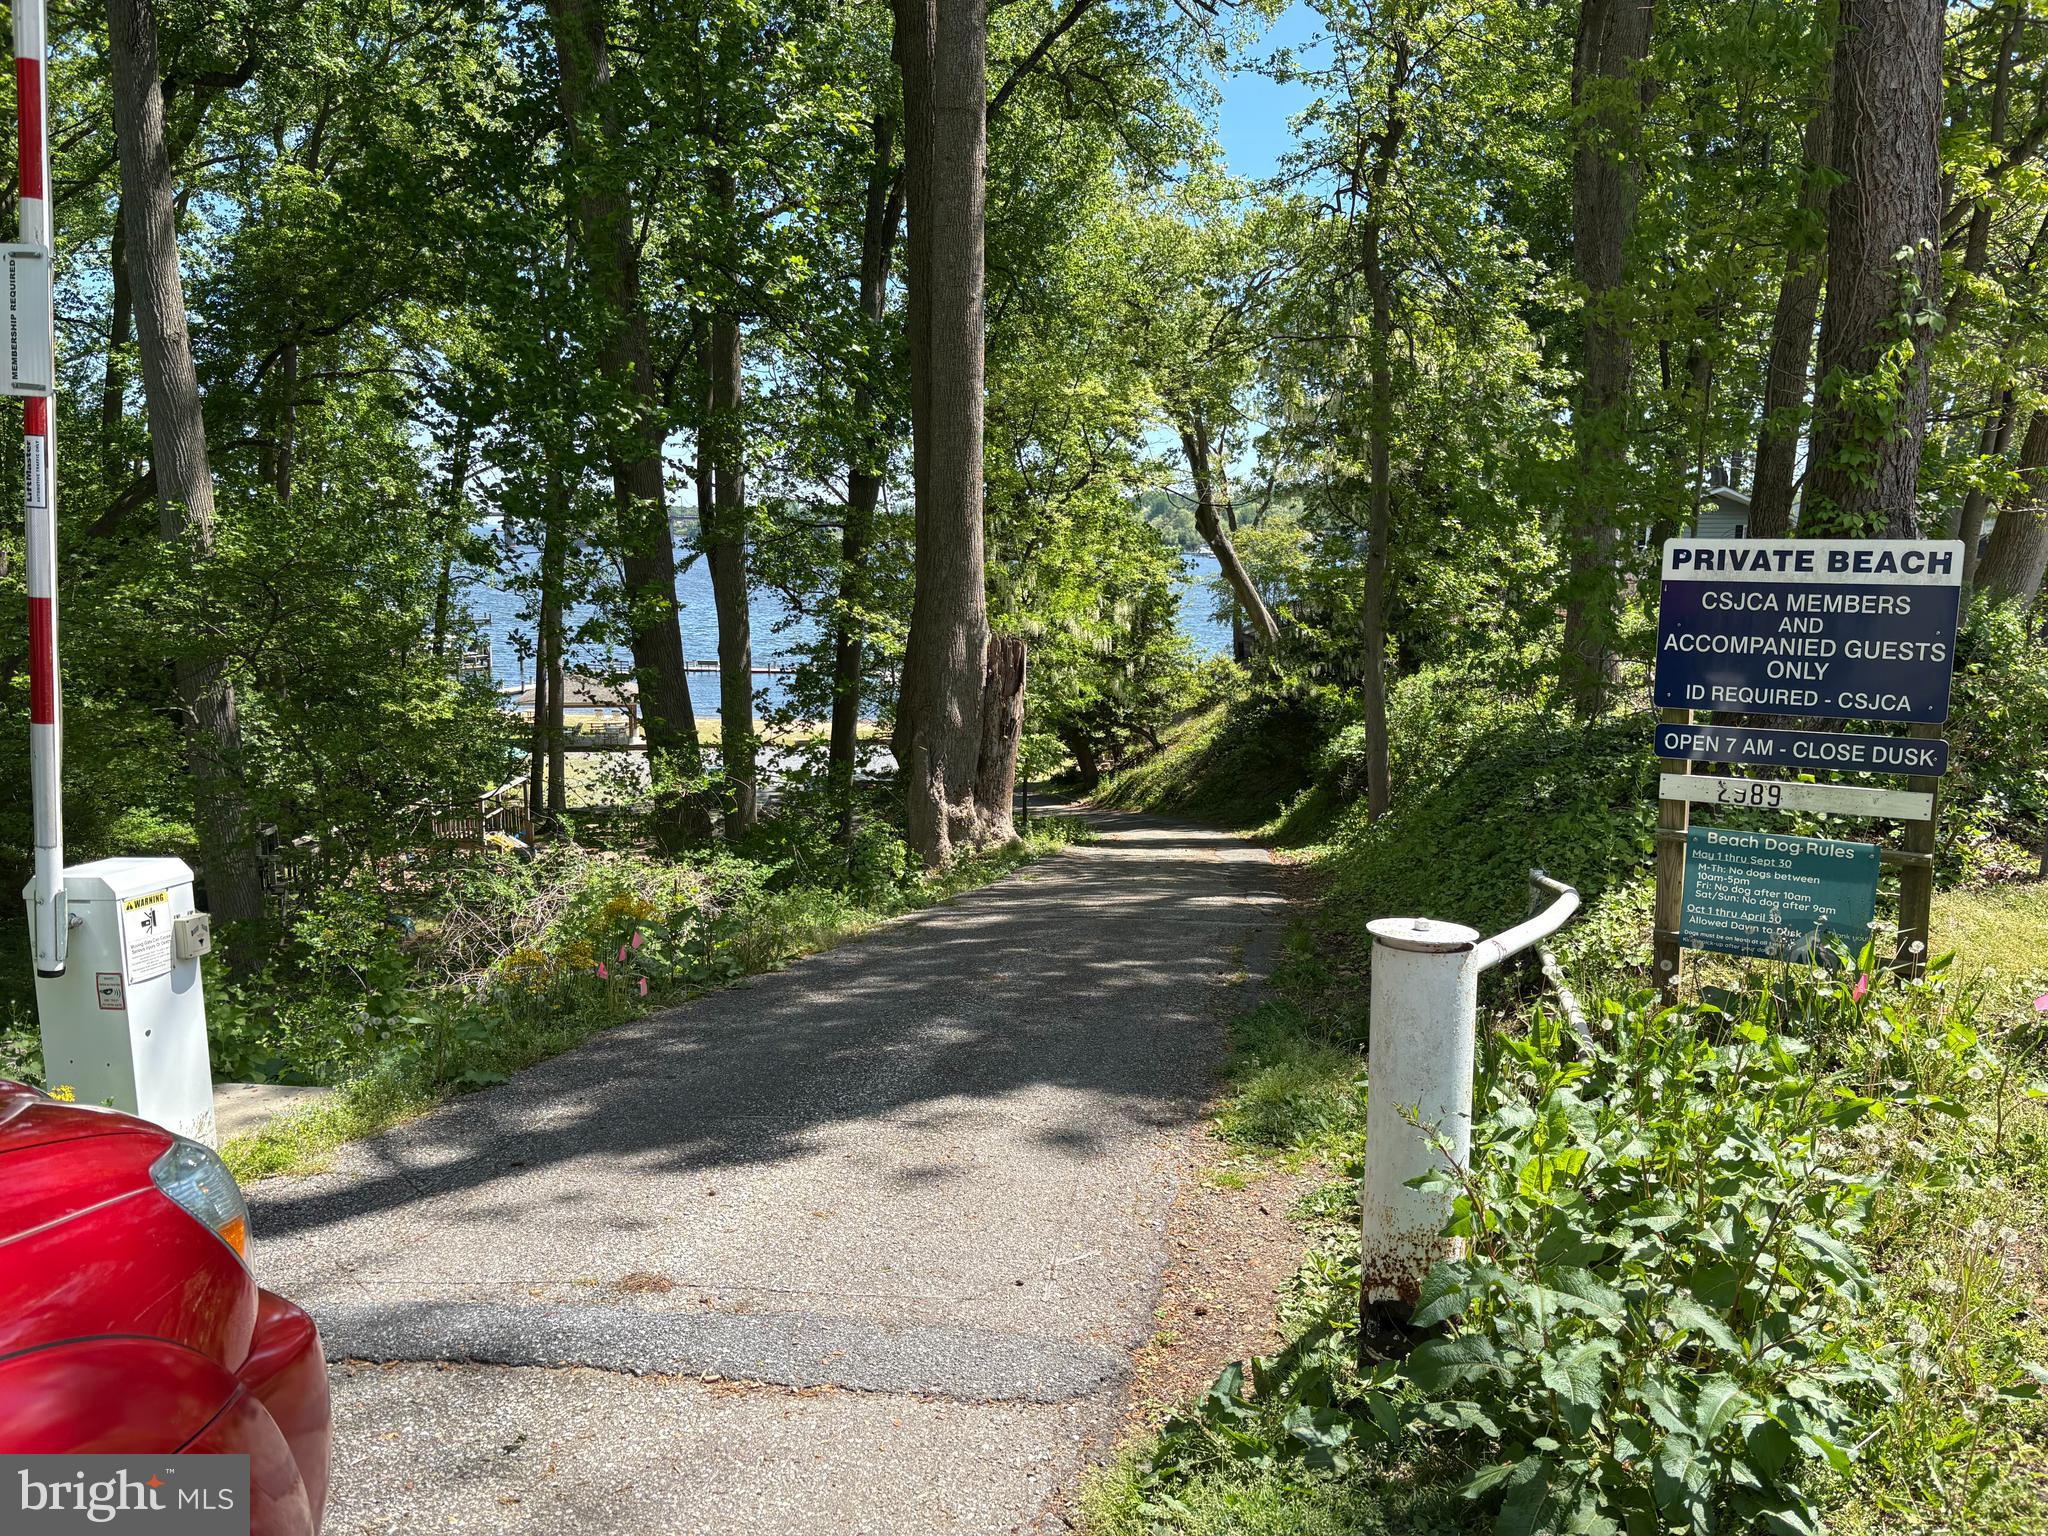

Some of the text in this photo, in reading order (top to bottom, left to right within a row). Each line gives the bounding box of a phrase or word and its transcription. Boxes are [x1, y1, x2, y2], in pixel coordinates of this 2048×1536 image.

[1672, 548, 1953, 574] PRIVATE BEACH
[1702, 592, 1912, 615] CSJCA MEMBERS
[1778, 616, 1824, 634] AND
[1664, 634, 1946, 662] ACCOMPANIED GUESTS
[1766, 660, 1830, 680] ONLY
[1686, 684, 1706, 700] ID
[1712, 686, 1818, 706] REQUIRED
[1838, 692, 1912, 712] CSJCA
[1664, 732, 1720, 752] OPEN
[1726, 738, 1737, 753] 7
[1742, 738, 1774, 756] AM
[1792, 741, 1866, 762] CLOSE
[1872, 746, 1936, 767] DUSK
[1708, 832, 1855, 859] Beach Dog Rules
[1692, 849, 1792, 868] May 1 thru Sept 30
[1698, 863, 1820, 884] M-Th: No dogs between
[1698, 872, 1750, 886] 10am-5pm
[134, 894, 164, 908] WARNING
[1696, 880, 1812, 902] Fri: No dog after 10am
[1695, 890, 1836, 914] Sat/Sun: No dog after 9am
[1686, 904, 1782, 924] Oct 1 thru April 30
[1688, 916, 1728, 928] Allowed
